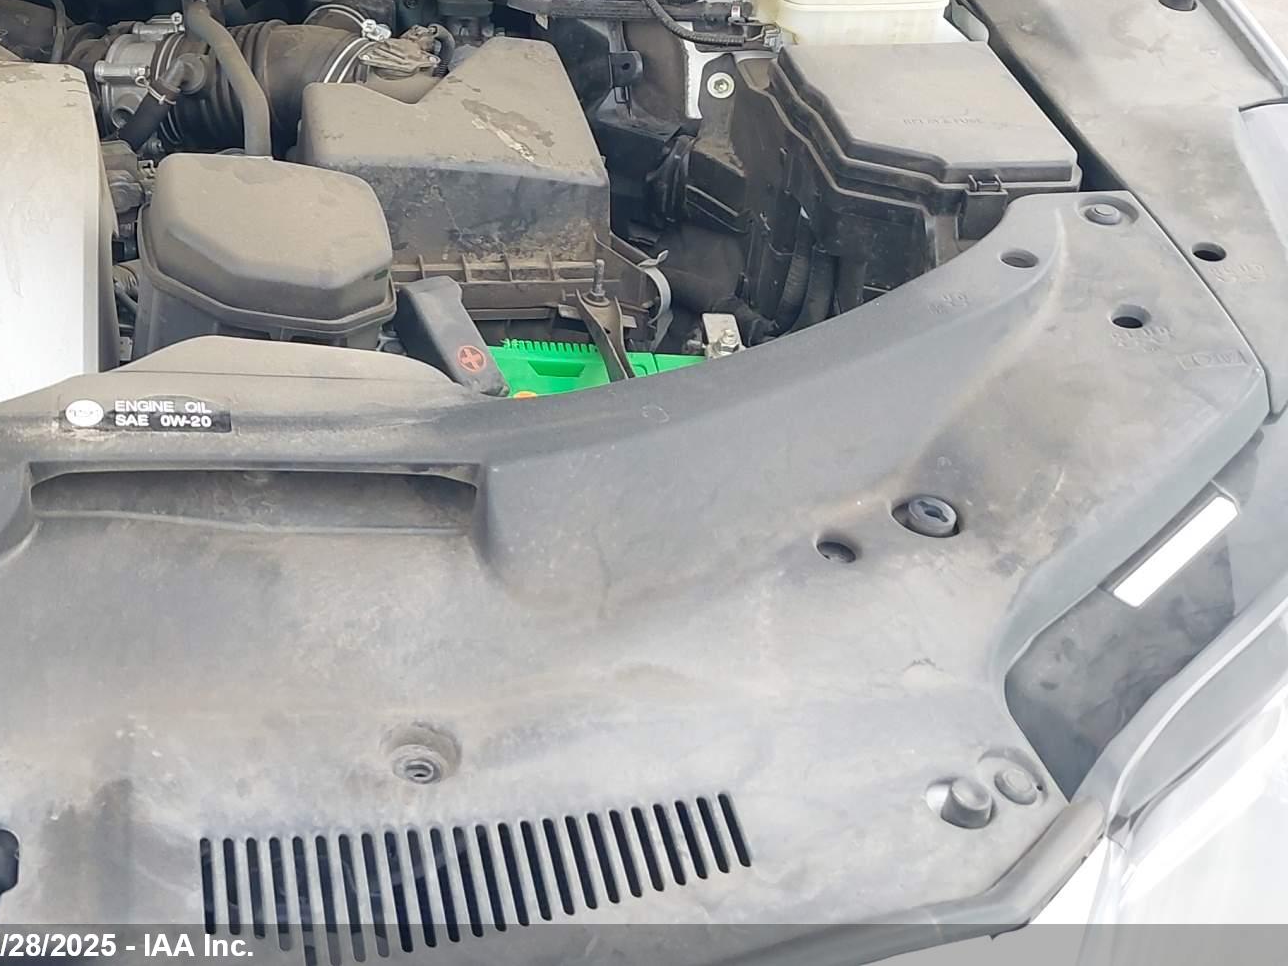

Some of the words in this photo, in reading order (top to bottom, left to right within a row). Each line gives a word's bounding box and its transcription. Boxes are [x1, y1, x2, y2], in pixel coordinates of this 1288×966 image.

[114, 400, 174, 413] ENGINE
[184, 401, 212, 414] OIL
[114, 414, 150, 427] SAE
[160, 414, 212, 428] 0W-20
